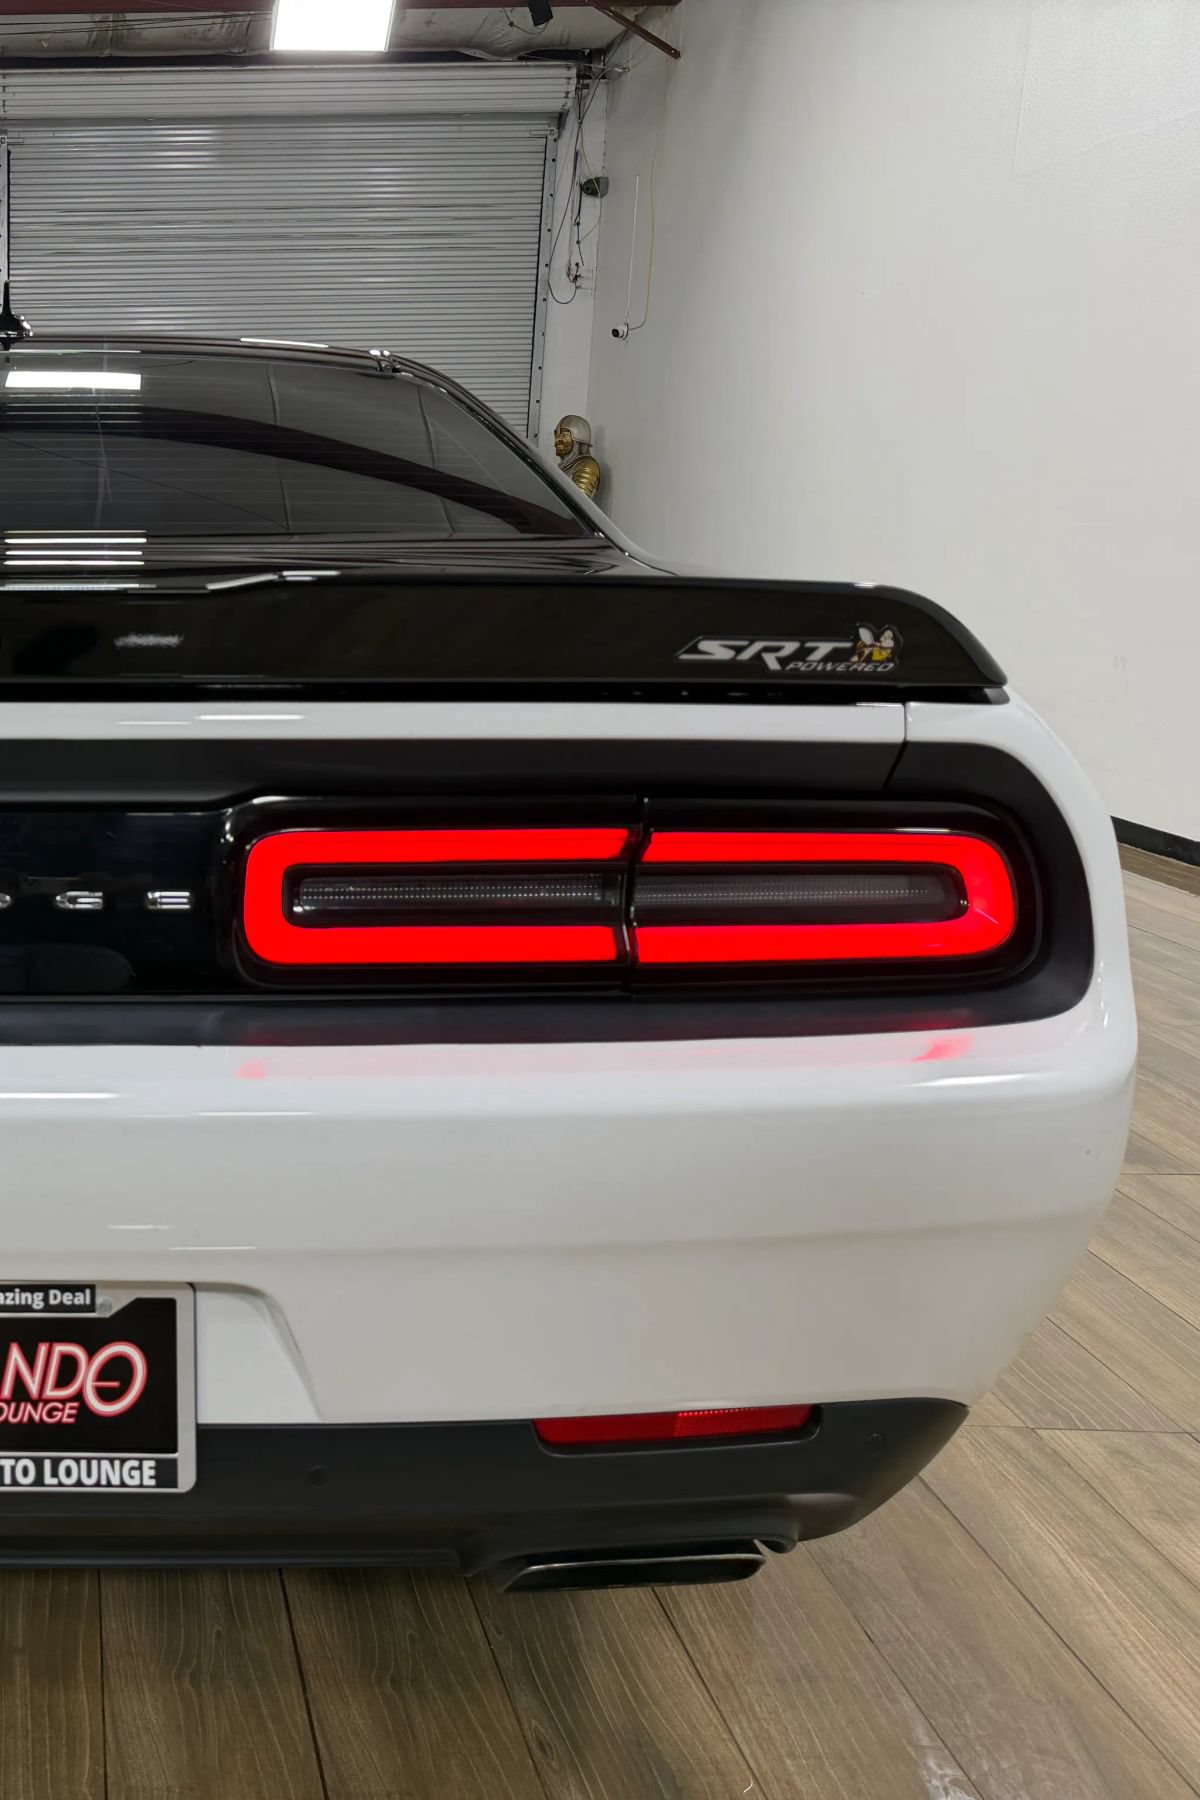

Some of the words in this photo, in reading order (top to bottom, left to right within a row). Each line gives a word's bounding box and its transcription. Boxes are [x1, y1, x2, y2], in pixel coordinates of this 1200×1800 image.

[678, 640, 853, 671] SRT
[786, 661, 895, 673] POWERED
[48, 1288, 92, 1306] Deal
[43, 1458, 157, 1487] LOUNGE
